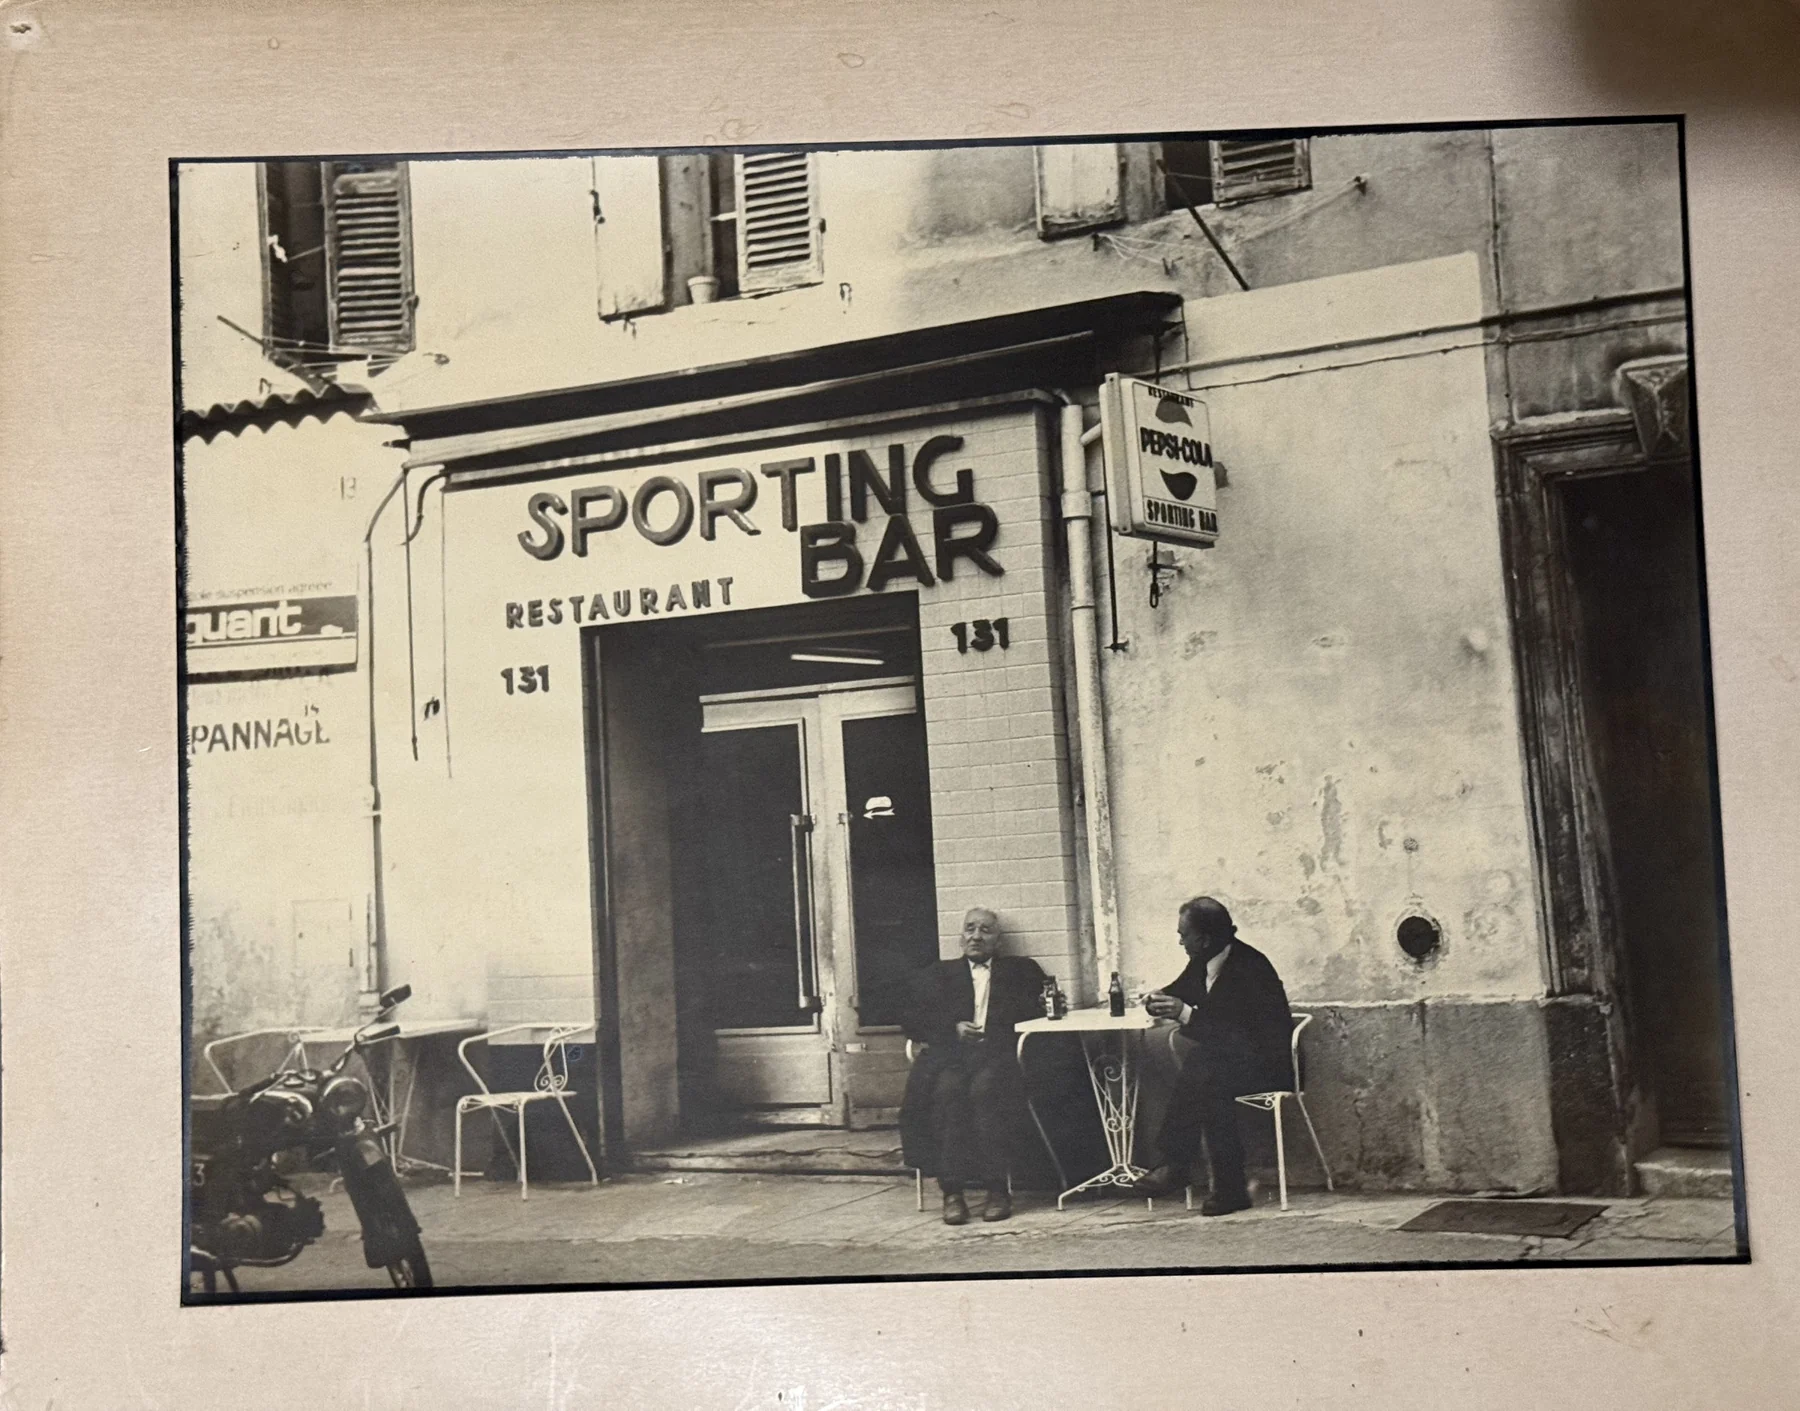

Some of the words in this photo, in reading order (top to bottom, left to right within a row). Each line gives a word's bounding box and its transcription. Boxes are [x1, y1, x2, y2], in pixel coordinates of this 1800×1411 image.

[1140, 427, 1213, 468] PEPSI-COLA
[517, 434, 975, 561] SPORTING
[1147, 499, 1195, 528] SPORTING
[1199, 510, 1218, 533] BAR
[800, 502, 1005, 599] BAR
[505, 576, 734, 629] RESTAURANT
[950, 617, 1010, 654] 131
[500, 664, 550, 695] 131
